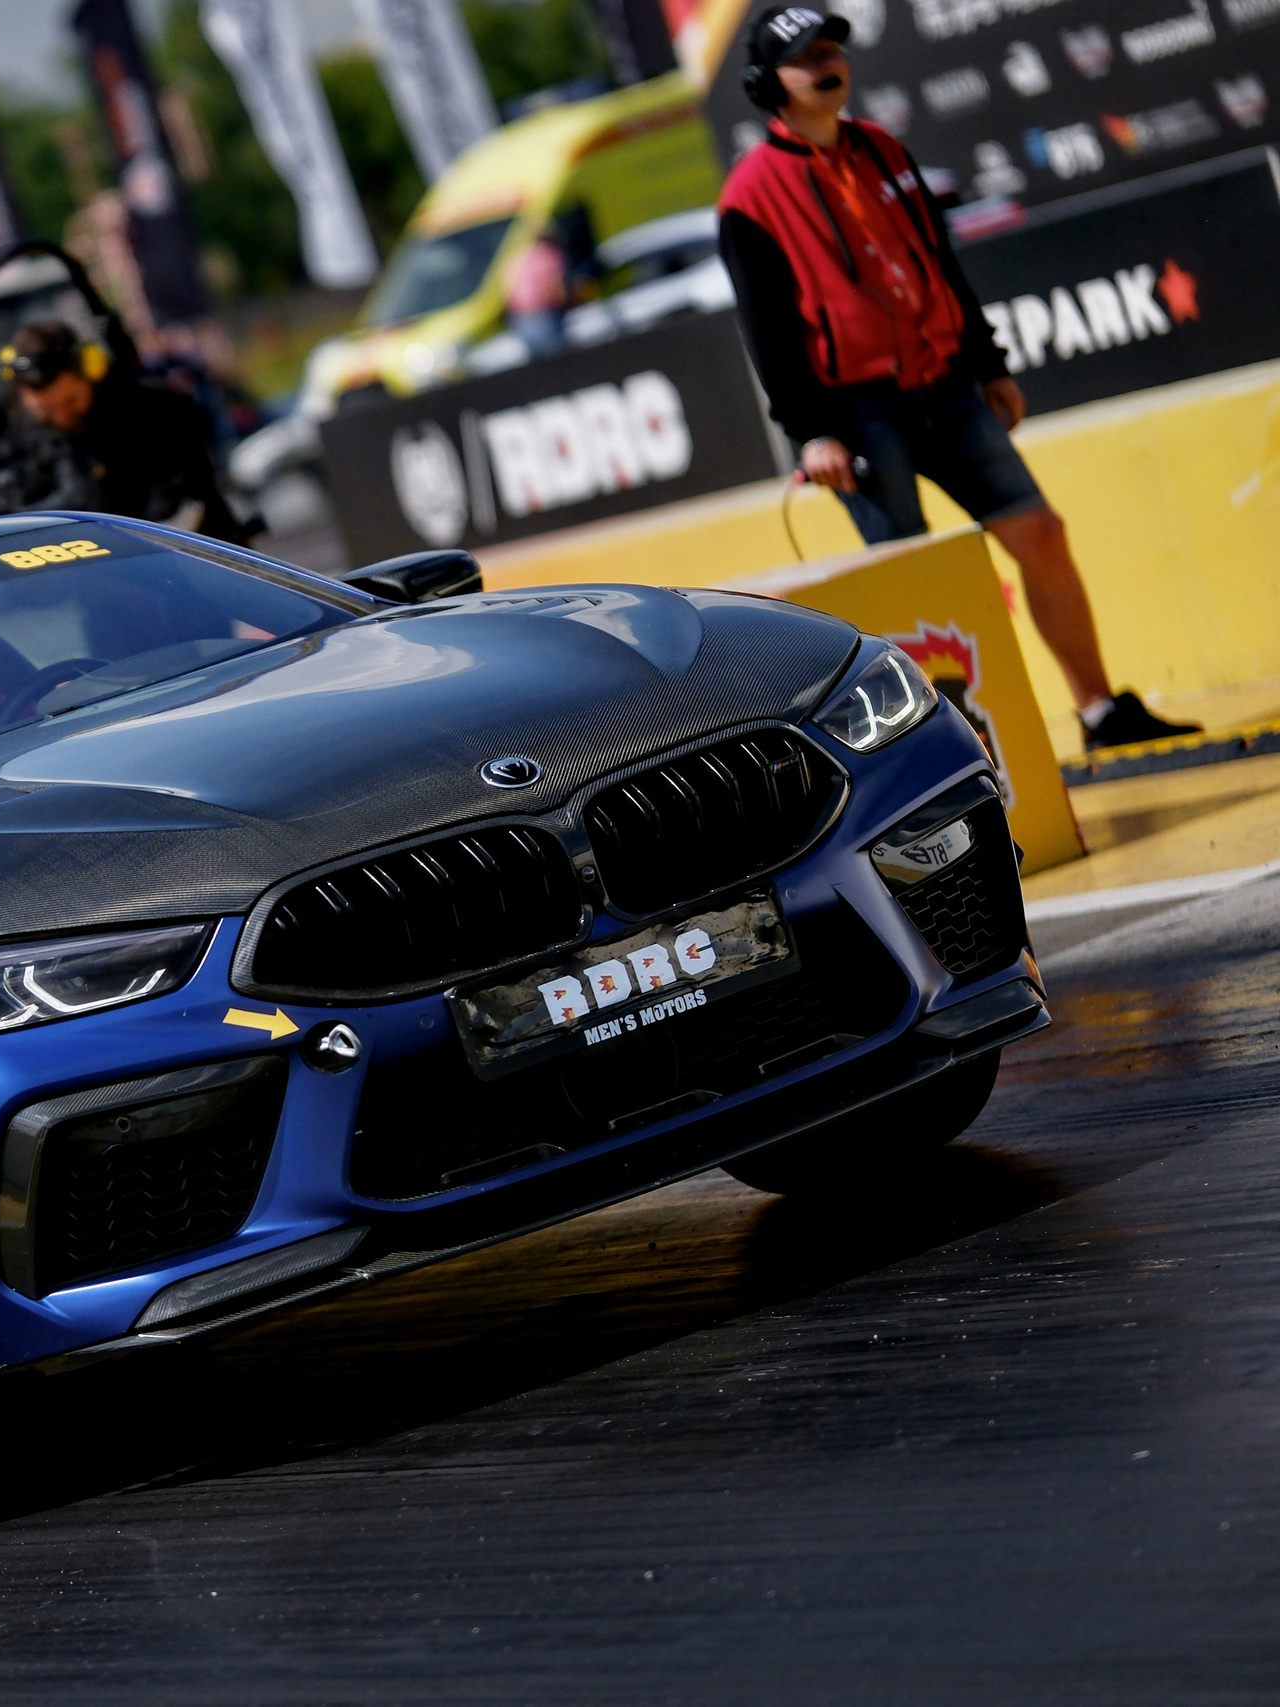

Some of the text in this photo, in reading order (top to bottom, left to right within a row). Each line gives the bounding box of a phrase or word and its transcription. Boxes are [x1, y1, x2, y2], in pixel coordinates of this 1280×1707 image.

[537, 927, 717, 1026] RDRC
[583, 988, 708, 1046] MEN'S MOTORS
